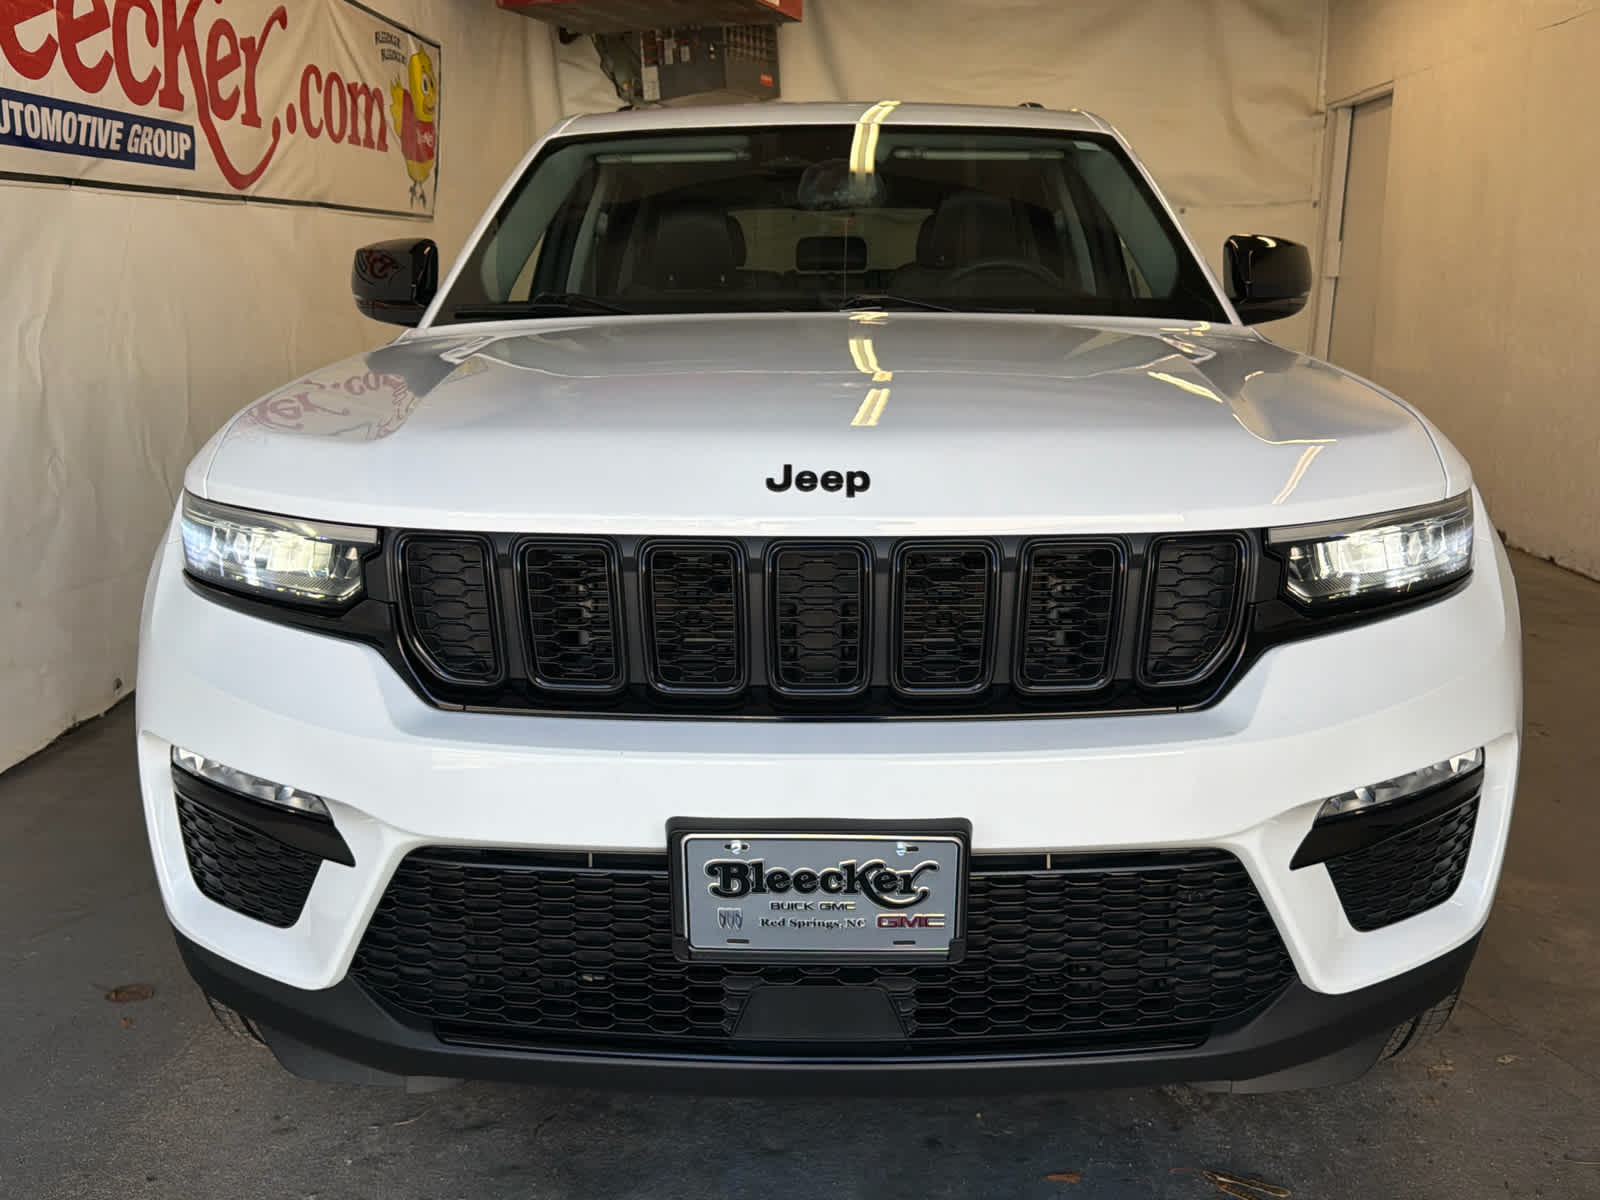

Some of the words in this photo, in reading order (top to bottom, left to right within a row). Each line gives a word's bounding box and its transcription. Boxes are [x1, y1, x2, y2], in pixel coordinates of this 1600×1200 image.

[127, 124, 192, 161] GROUP
[765, 464, 871, 498] Jeep
[770, 901, 814, 911] BUICK
[819, 901, 857, 911] GMC
[760, 917, 786, 928] Red
[789, 917, 842, 930] Springs,
[845, 917, 867, 929] NC
[877, 913, 945, 929] GMC
